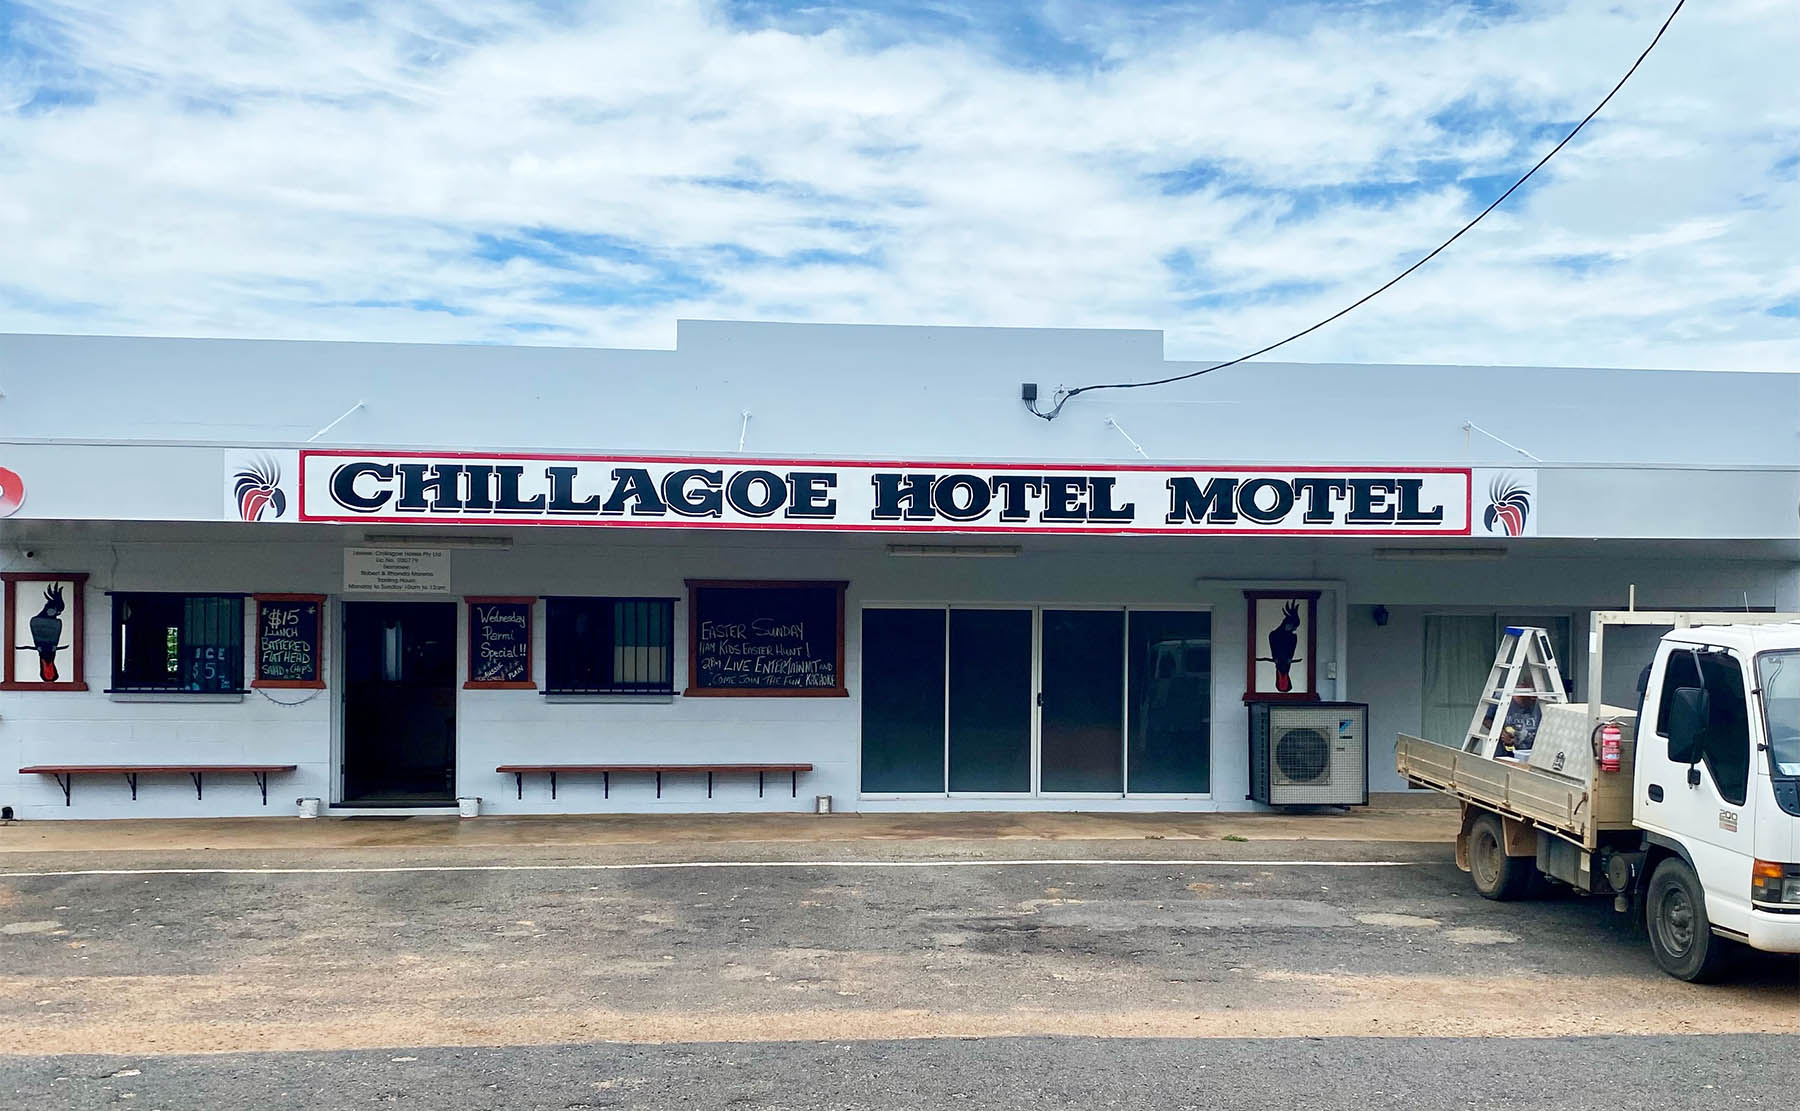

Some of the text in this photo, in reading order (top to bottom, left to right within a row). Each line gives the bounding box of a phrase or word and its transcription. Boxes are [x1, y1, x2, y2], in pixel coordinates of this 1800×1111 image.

[329, 462, 1443, 525] CHILLAGOE HOTEL MOTEL
[268, 608, 300, 629] $15
[477, 606, 526, 629] Wednesday
[264, 626, 298, 637] LUNCH
[482, 625, 514, 641] Parmi
[702, 617, 804, 641] EASTER SUNDAY
[261, 637, 311, 652] BATTERED
[719, 639, 741, 656] KIDS
[742, 642, 774, 656] EASTER
[195, 647, 226, 660] ICE
[723, 655, 752, 672] LIVE
